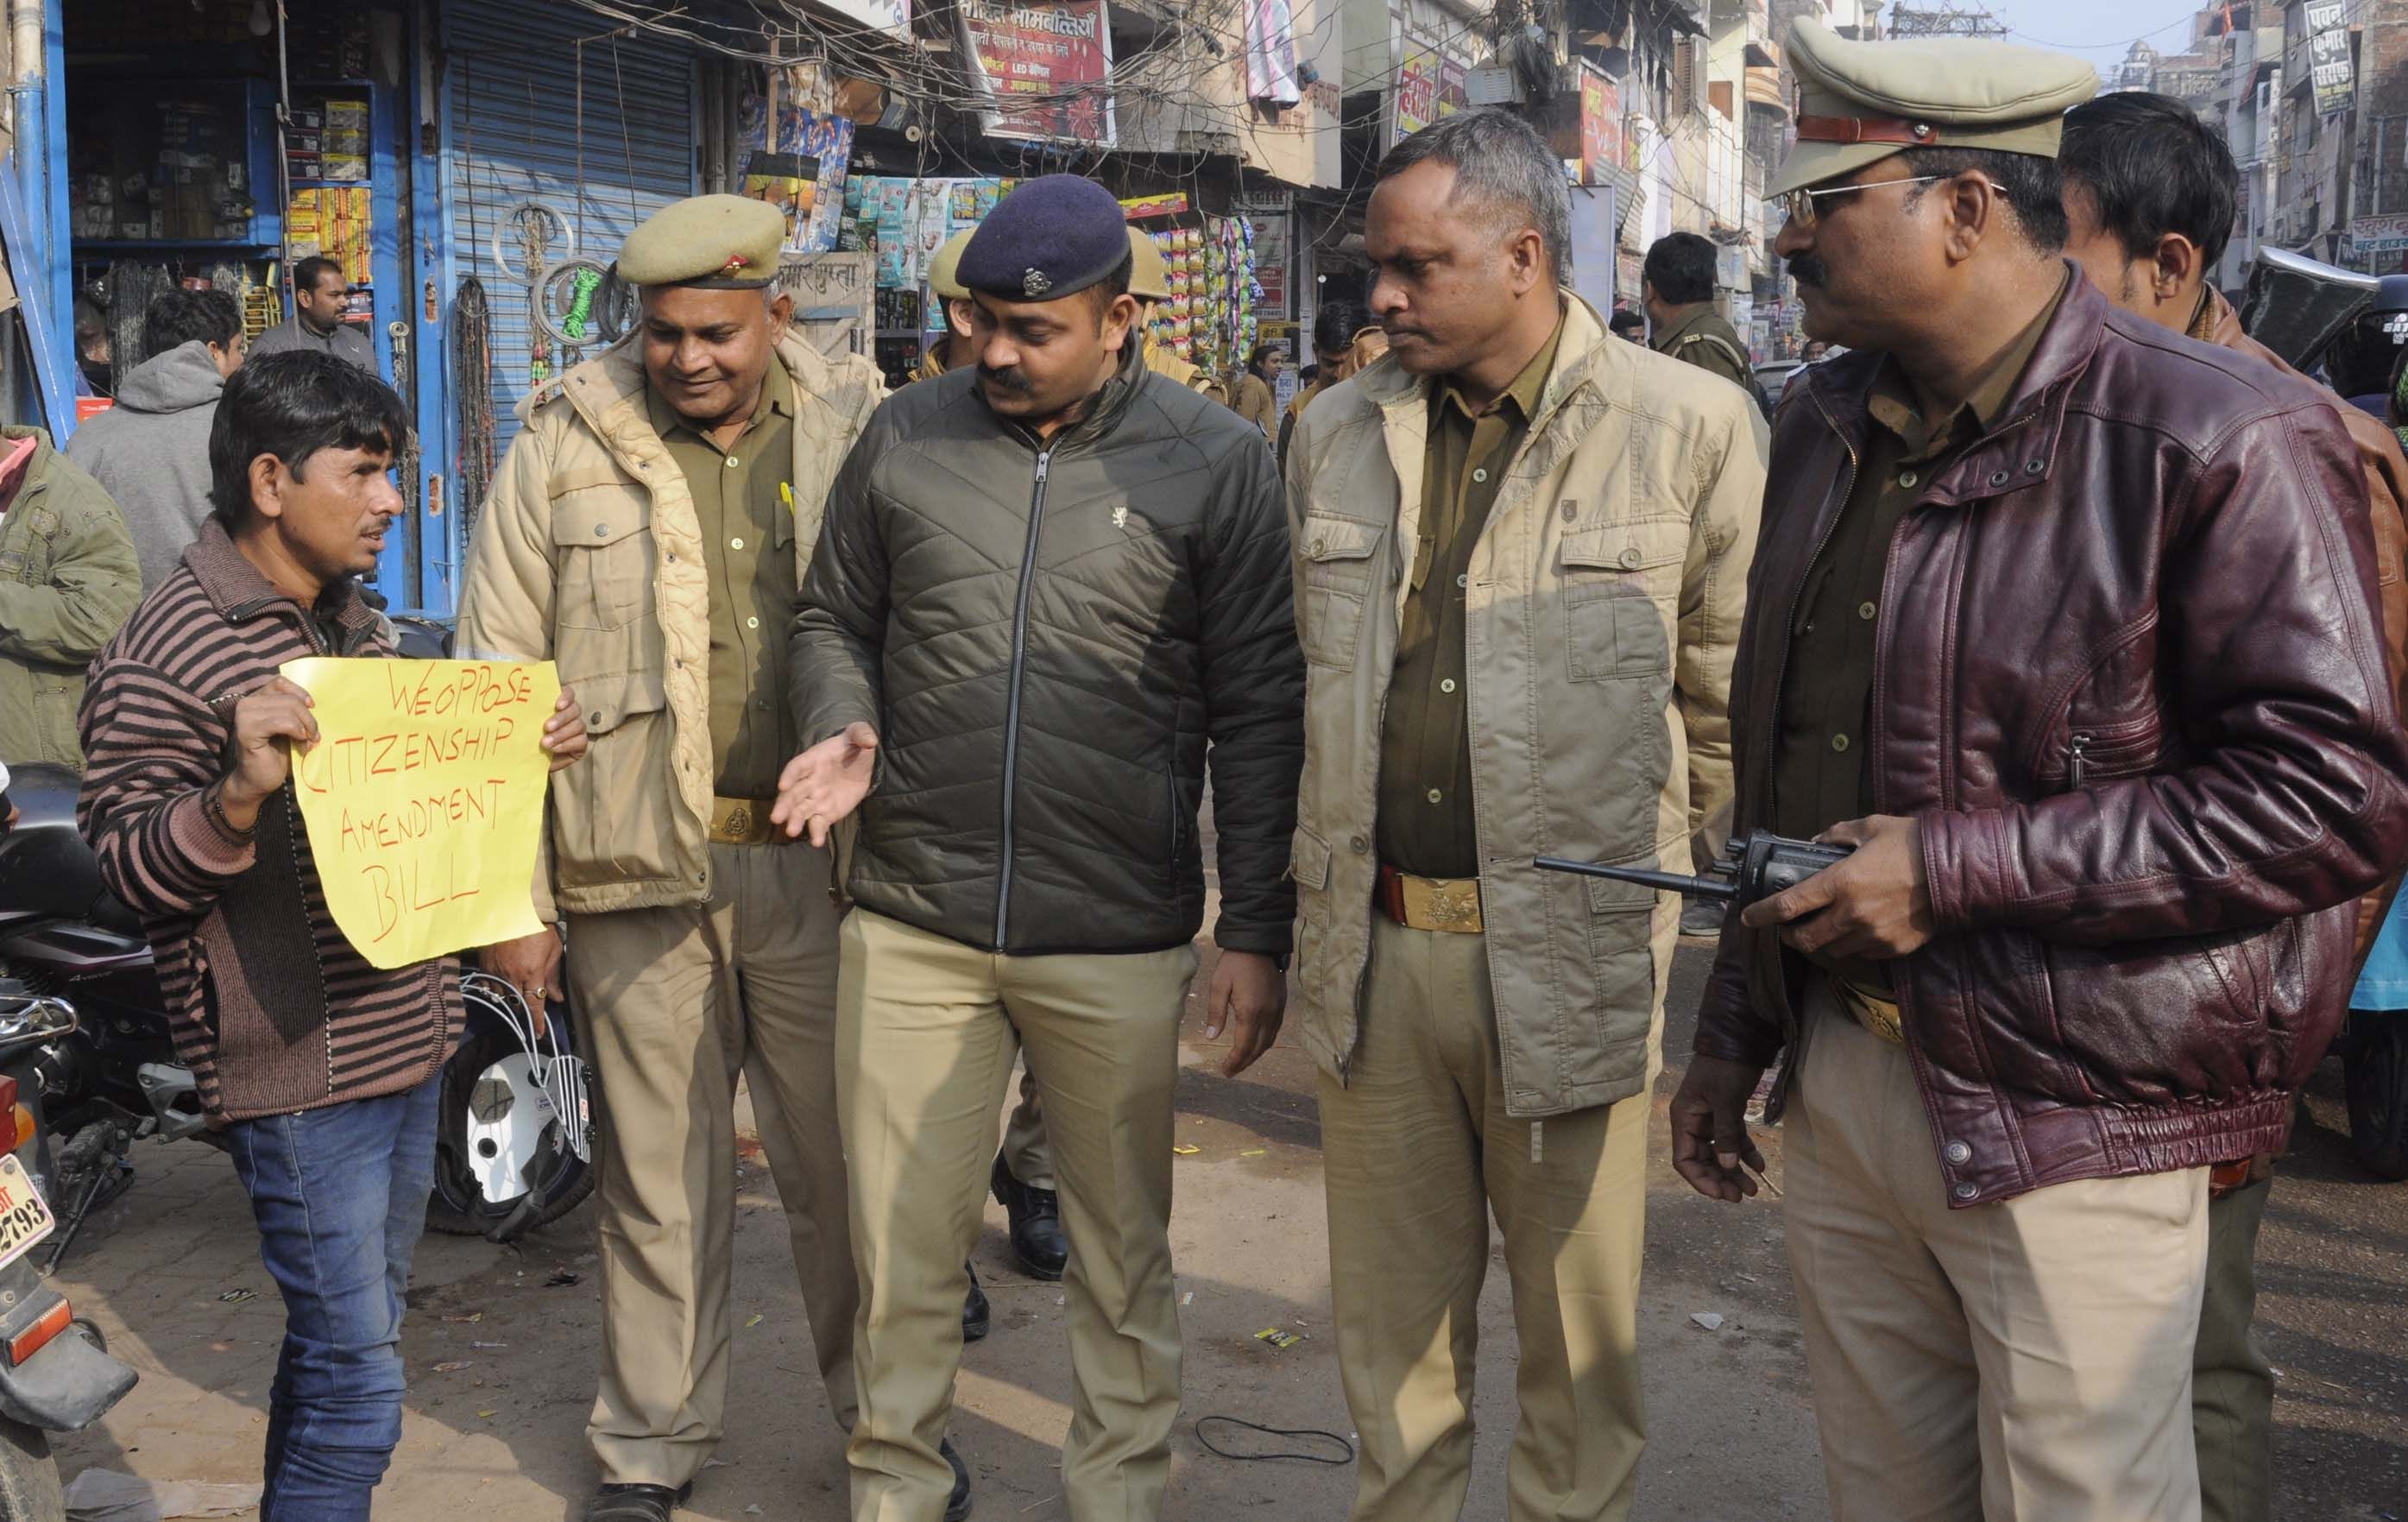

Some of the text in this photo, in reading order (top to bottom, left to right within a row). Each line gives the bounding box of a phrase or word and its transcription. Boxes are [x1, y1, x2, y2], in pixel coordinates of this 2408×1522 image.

[2309, 3, 2342, 28] पवन
[1012, 62, 1026, 74] LED
[2313, 28, 2348, 61] कुमार
[300, 717, 514, 794] CITIZENSHIP
[341, 779, 507, 854] AMENDMENT
[362, 852, 480, 943] BILL
